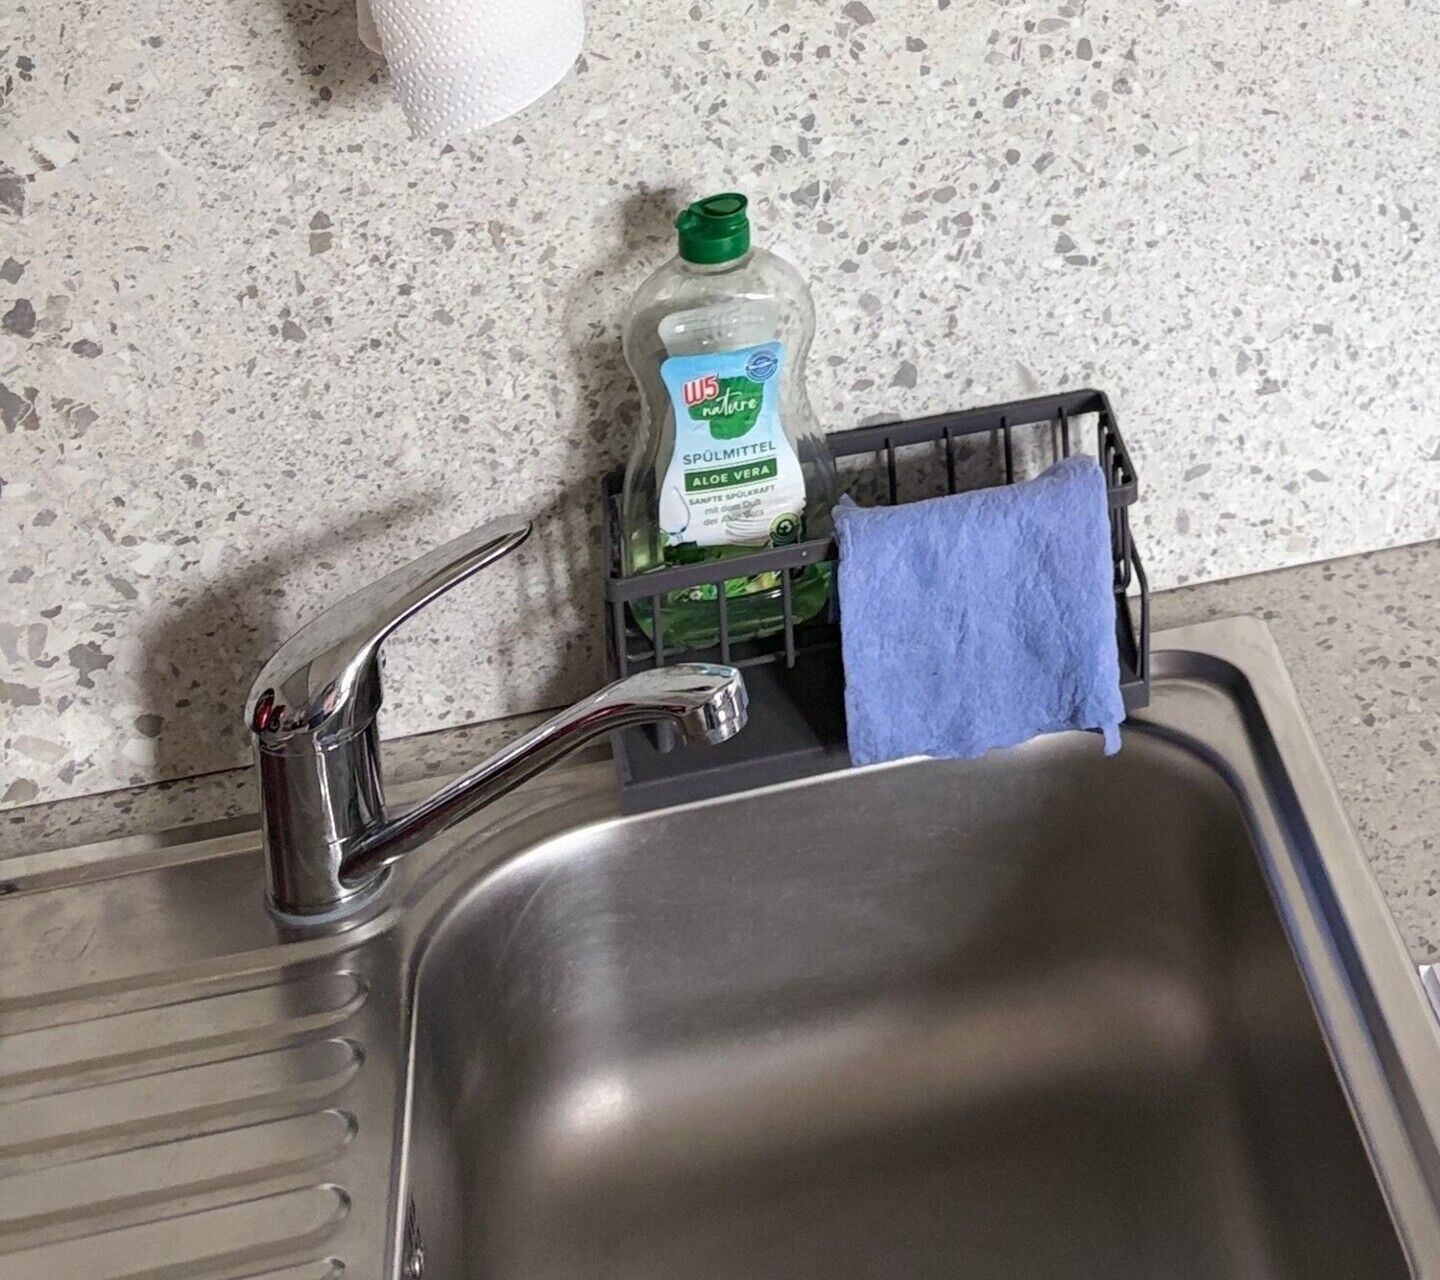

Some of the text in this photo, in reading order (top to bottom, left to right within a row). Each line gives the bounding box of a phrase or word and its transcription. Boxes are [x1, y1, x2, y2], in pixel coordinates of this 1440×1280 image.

[683, 374, 719, 406] W5
[702, 387, 757, 416] nature
[682, 440, 777, 466] SPÜLMITTEL
[691, 465, 771, 488] ALOE VERA
[688, 485, 775, 506] SANFTE SPÜLKRAFT
